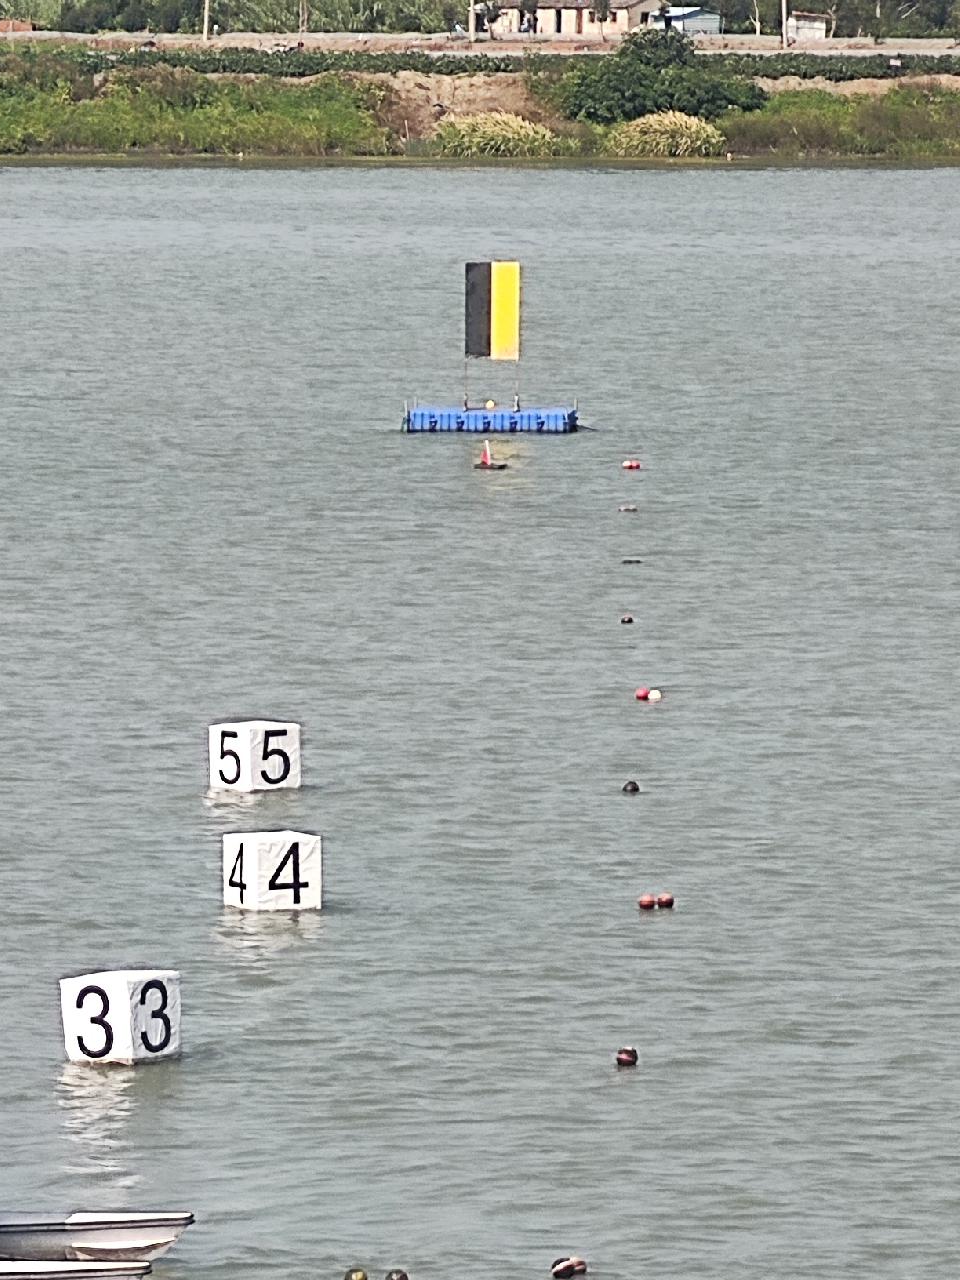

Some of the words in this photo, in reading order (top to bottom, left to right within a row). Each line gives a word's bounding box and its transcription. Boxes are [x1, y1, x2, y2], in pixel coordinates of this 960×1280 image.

[219, 730, 241, 784] 5
[261, 729, 291, 784] 5
[229, 842, 247, 905] 4
[268, 842, 309, 904] 4
[76, 985, 114, 1059] 3
[139, 979, 171, 1053] 3
